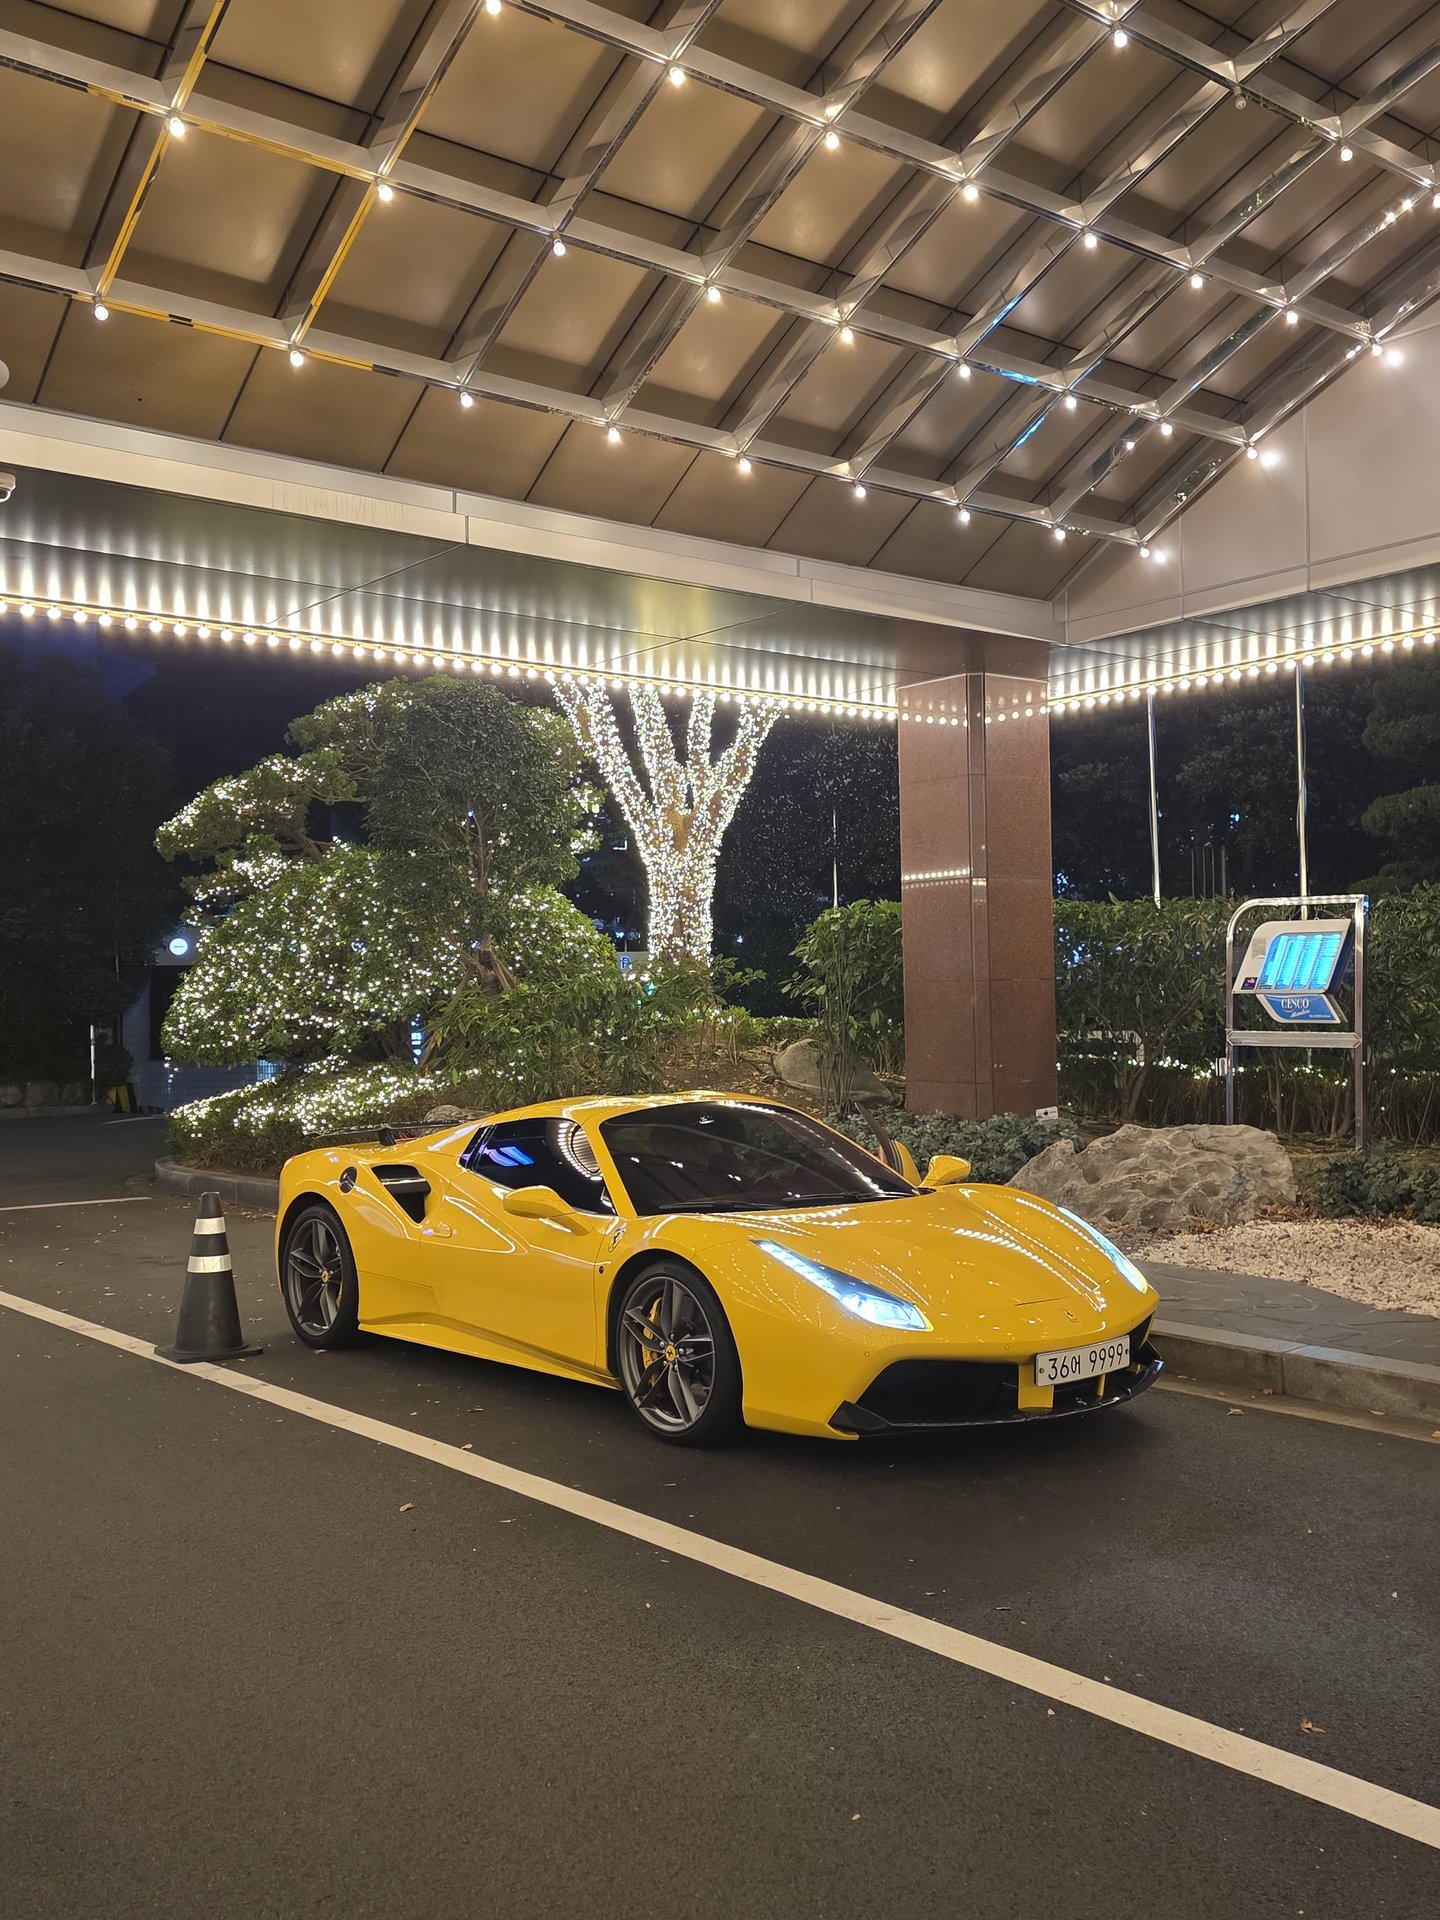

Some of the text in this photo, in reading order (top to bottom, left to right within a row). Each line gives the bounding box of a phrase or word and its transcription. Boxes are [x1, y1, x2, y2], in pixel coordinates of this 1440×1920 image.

[1281, 997, 1309, 1009] CESCO
[1048, 1343, 1124, 1381] 36어 9999
